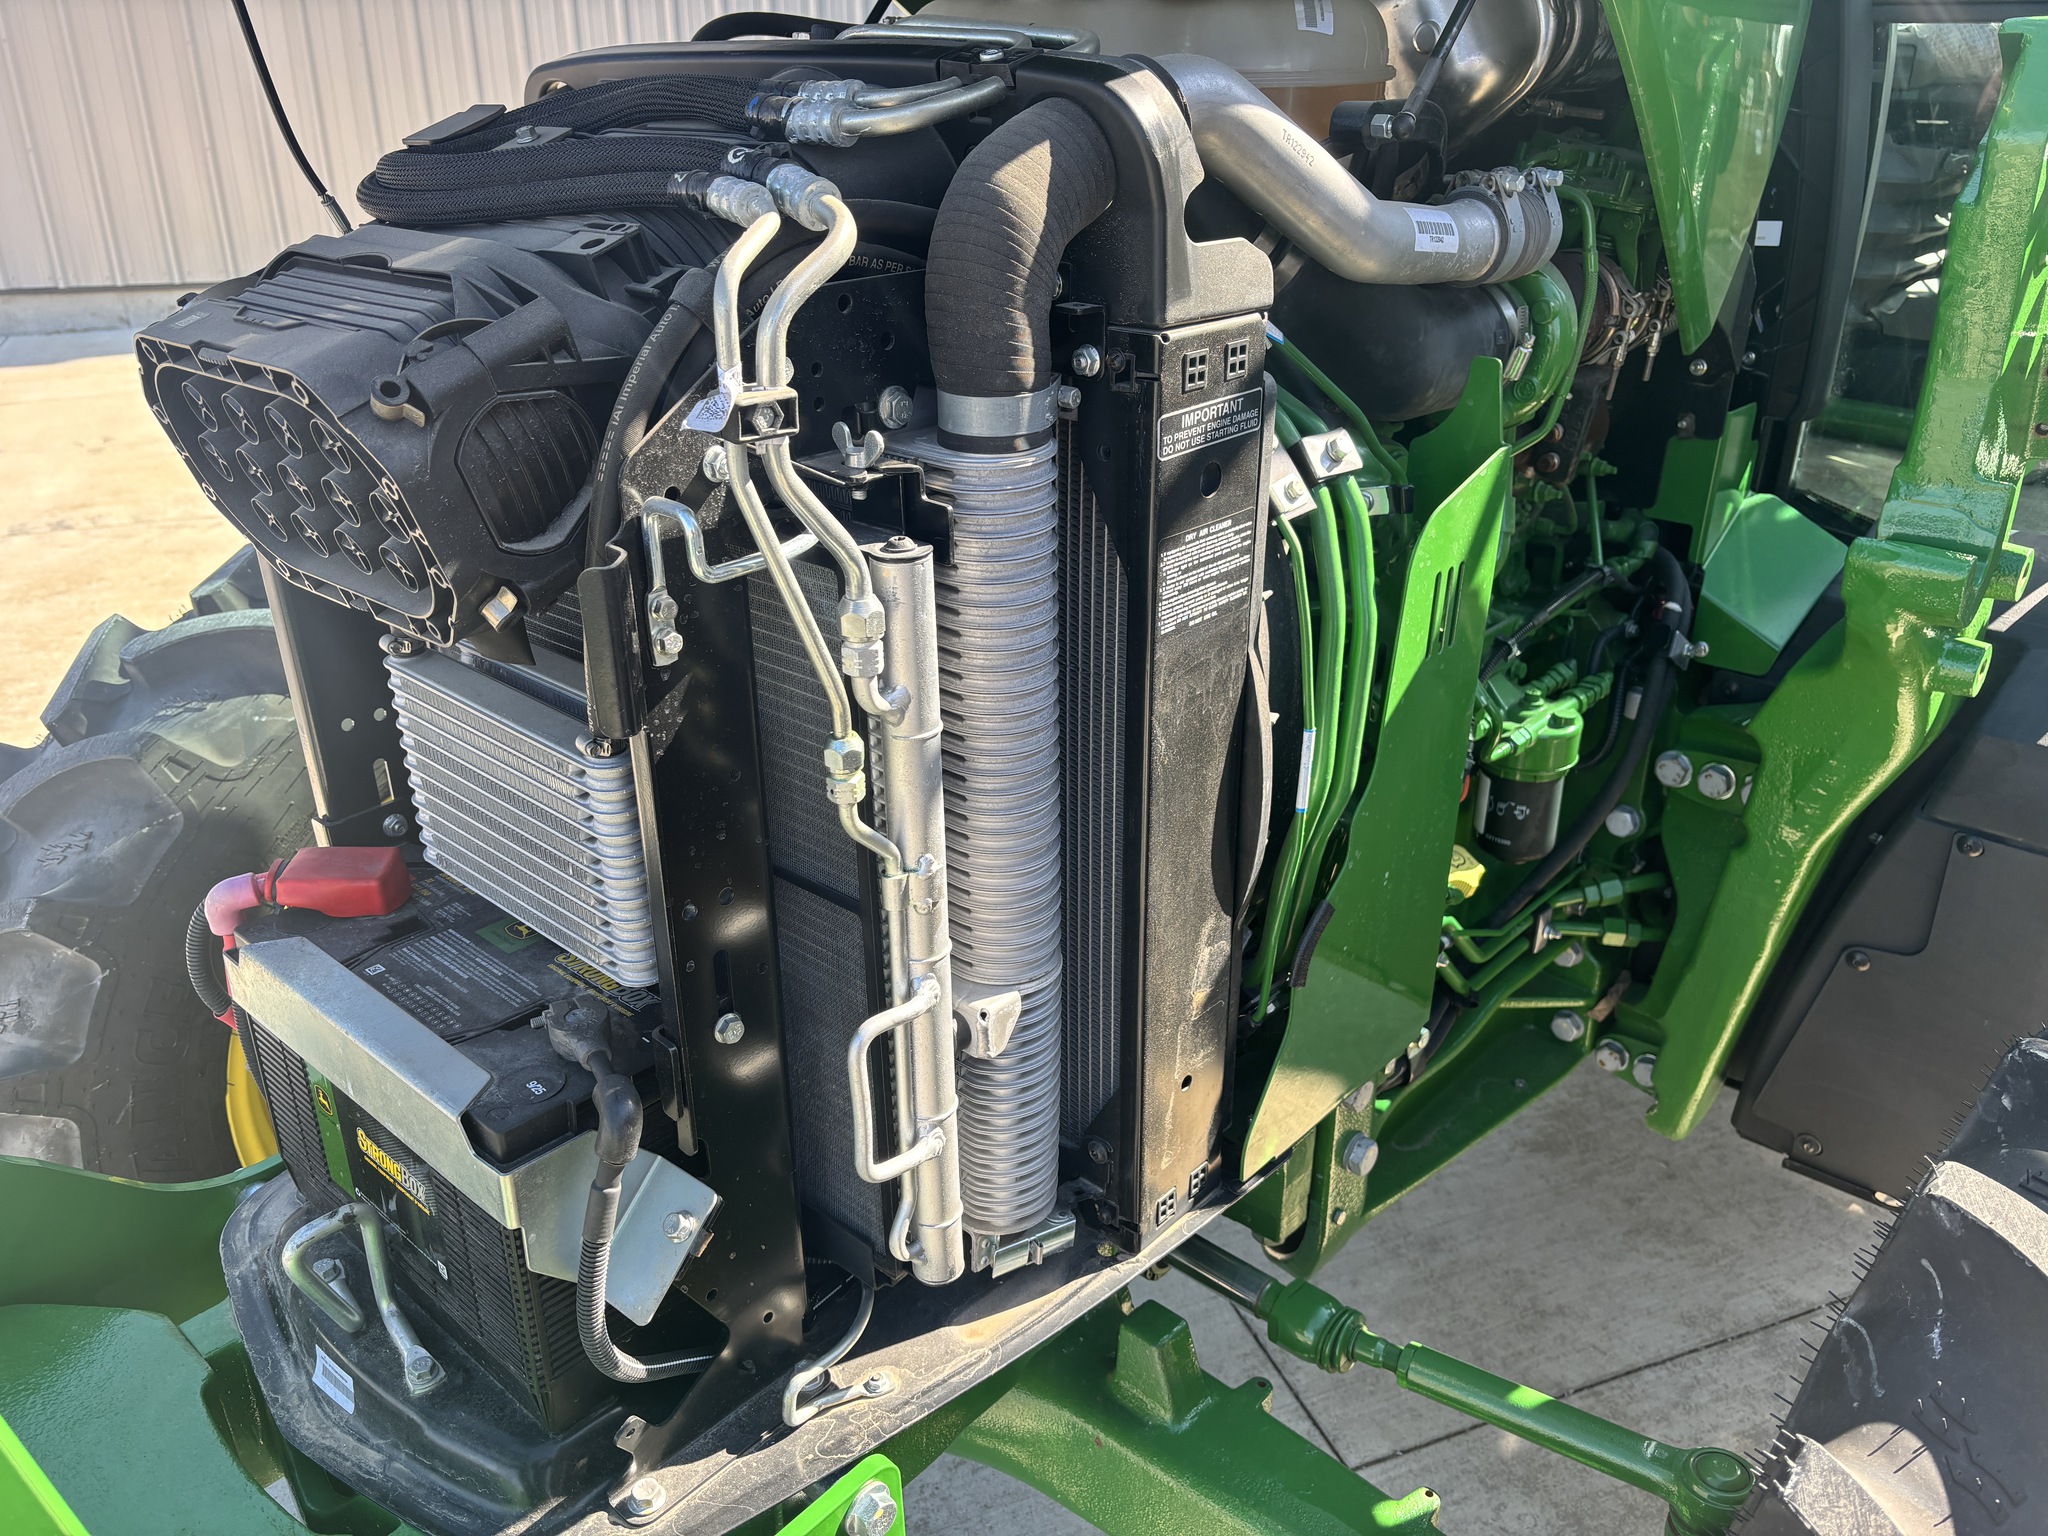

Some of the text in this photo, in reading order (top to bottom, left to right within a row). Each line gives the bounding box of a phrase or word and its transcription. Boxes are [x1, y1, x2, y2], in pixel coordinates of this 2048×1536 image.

[1283, 128, 1314, 166] TR122942
[849, 255, 869, 268] BAR
[870, 258, 884, 269] AS
[885, 261, 903, 273] PER
[650, 312, 672, 342] Auto
[1163, 408, 1259, 445] TO PREVENT ENGINE DAMAGE
[1181, 398, 1244, 428] IMPORTANT
[1162, 418, 1258, 456] DO NOT USE STARTING FLUID
[1185, 520, 1232, 542] DRY AIR CLEANER
[526, 1080, 546, 1095] 9/25
